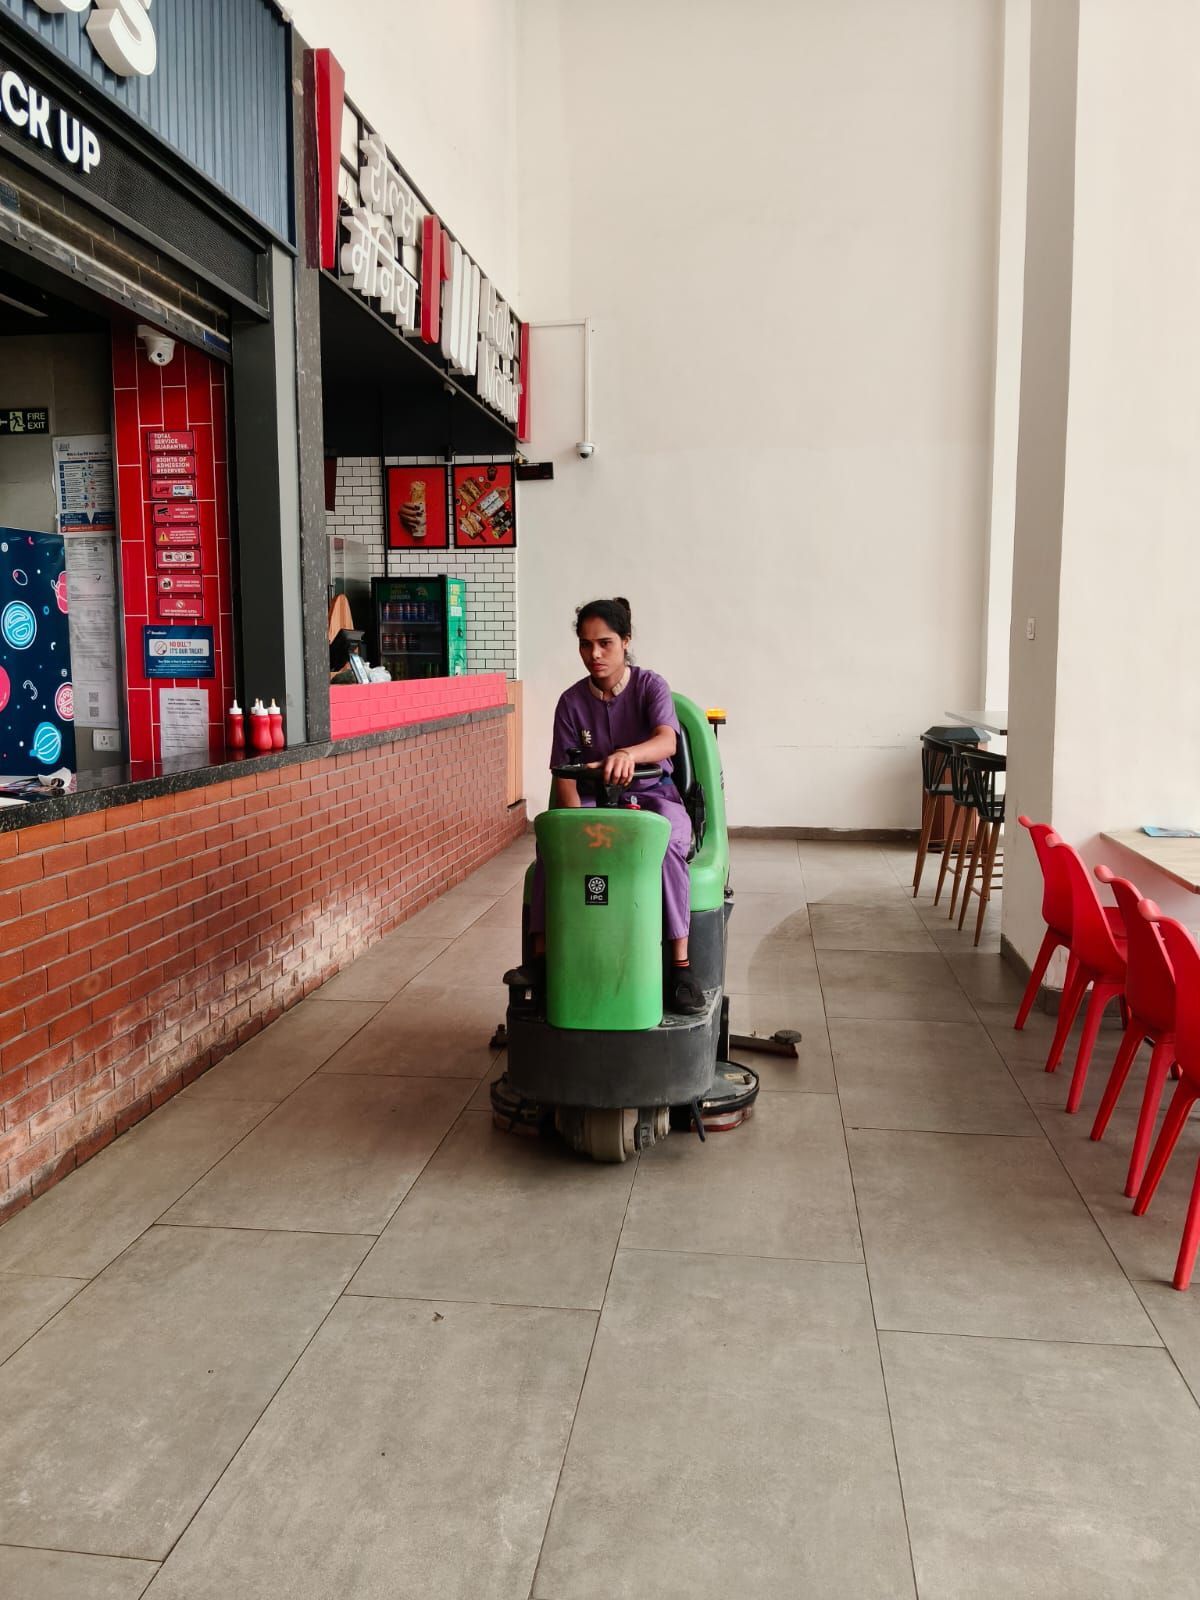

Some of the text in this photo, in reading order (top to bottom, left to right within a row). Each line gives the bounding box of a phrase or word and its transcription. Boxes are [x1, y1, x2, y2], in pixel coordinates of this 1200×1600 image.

[0, 70, 101, 174] CK UP
[27, 412, 45, 420] FIRE
[27, 421, 45, 429] EXIT
